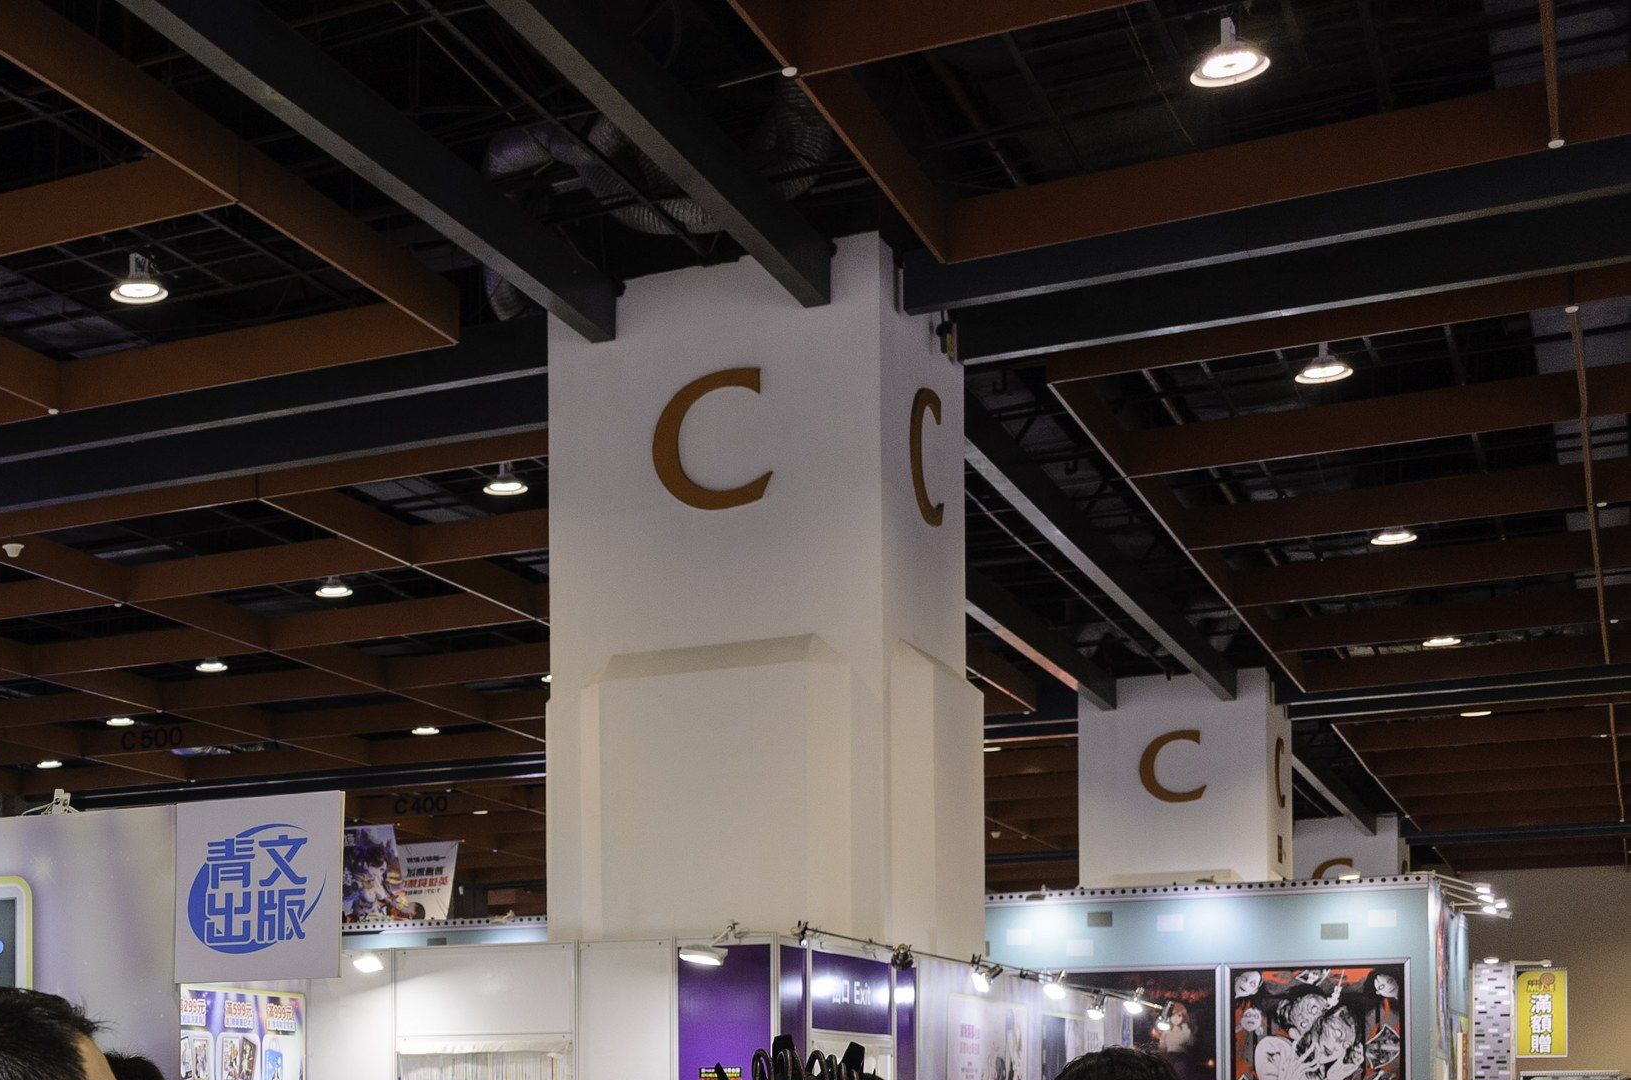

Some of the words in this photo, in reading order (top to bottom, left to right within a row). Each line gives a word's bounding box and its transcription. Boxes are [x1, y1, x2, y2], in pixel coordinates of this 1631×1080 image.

[652, 367, 773, 510] C
[910, 387, 944, 527] C
[1139, 729, 1206, 803] C
[394, 800, 406, 815] C
[412, 796, 448, 812] 400
[206, 834, 308, 889] 青文
[206, 888, 306, 945] 出版
[1530, 993, 1553, 1054] 滿額贈
